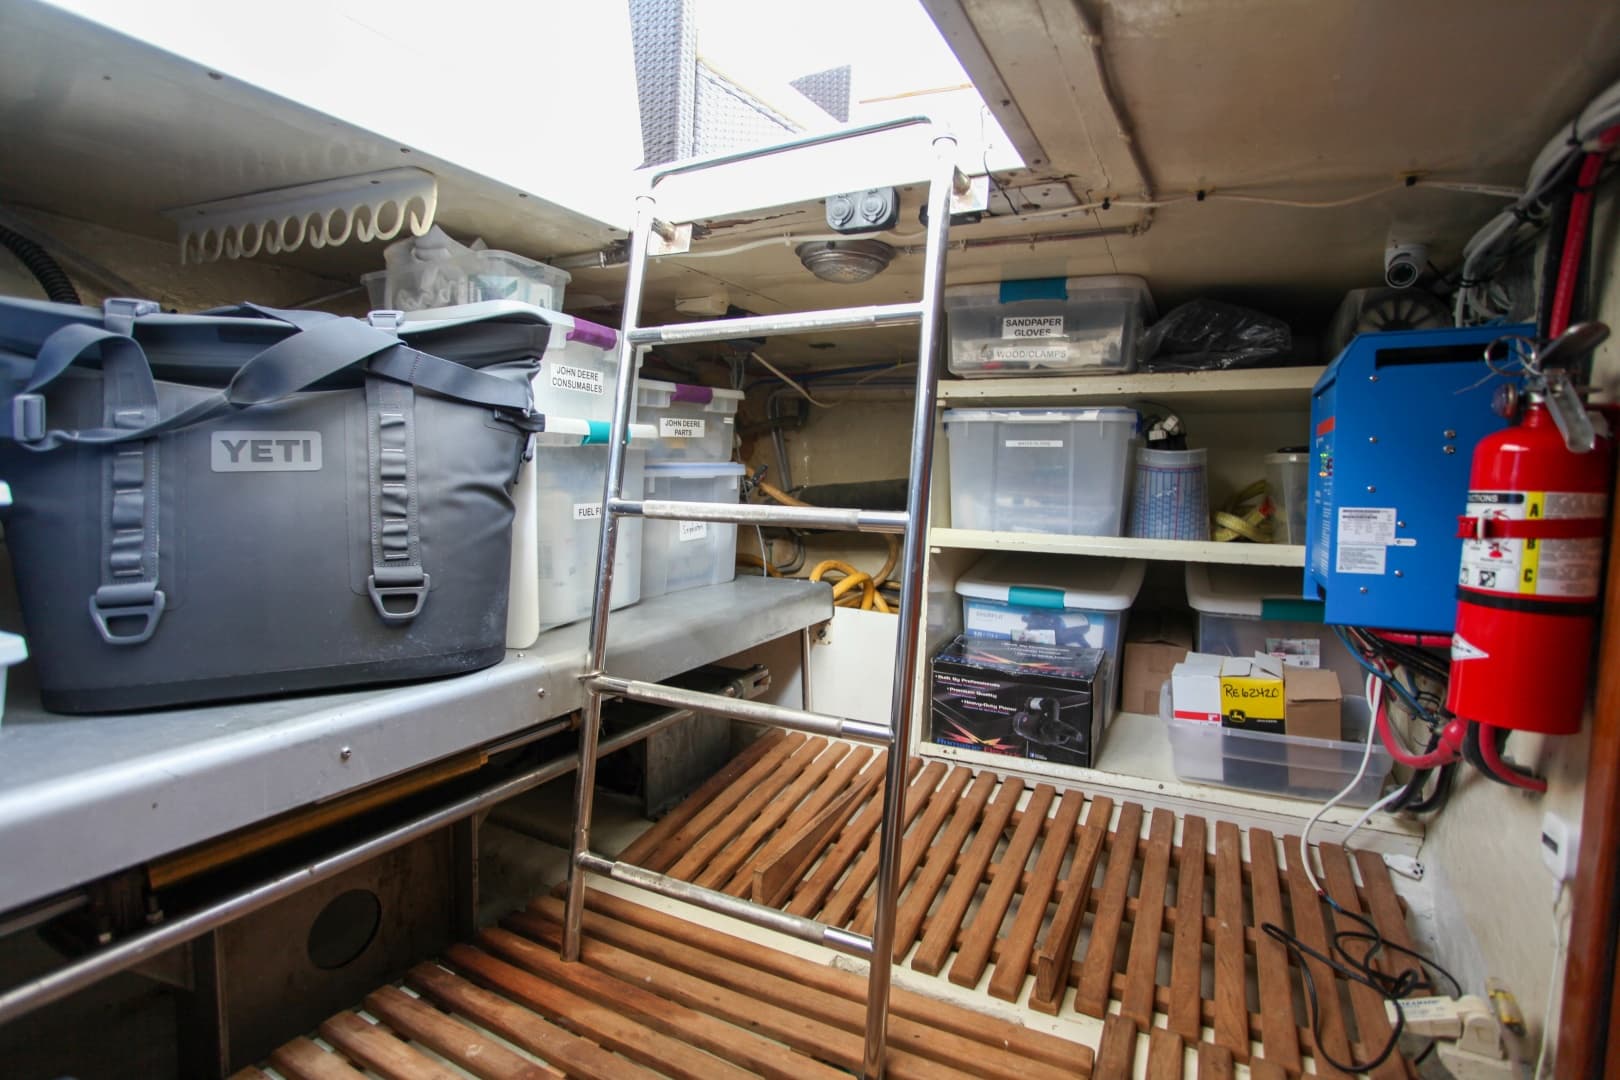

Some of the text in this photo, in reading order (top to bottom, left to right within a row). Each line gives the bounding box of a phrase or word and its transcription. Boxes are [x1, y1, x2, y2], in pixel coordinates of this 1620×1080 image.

[1005, 318, 1062, 327] SANDPAPER
[1014, 328, 1052, 337] GLOVES
[996, 350, 1067, 359] WOOD CLAMPS
[556, 366, 599, 382] JOHN DEERE
[552, 377, 603, 393] CONSUMABLES
[665, 419, 701, 428] JOHN DEERE
[220, 439, 312, 463] YETI
[578, 507, 595, 517] FUEL
[1529, 503, 1539, 517] A
[1523, 569, 1533, 583] C
